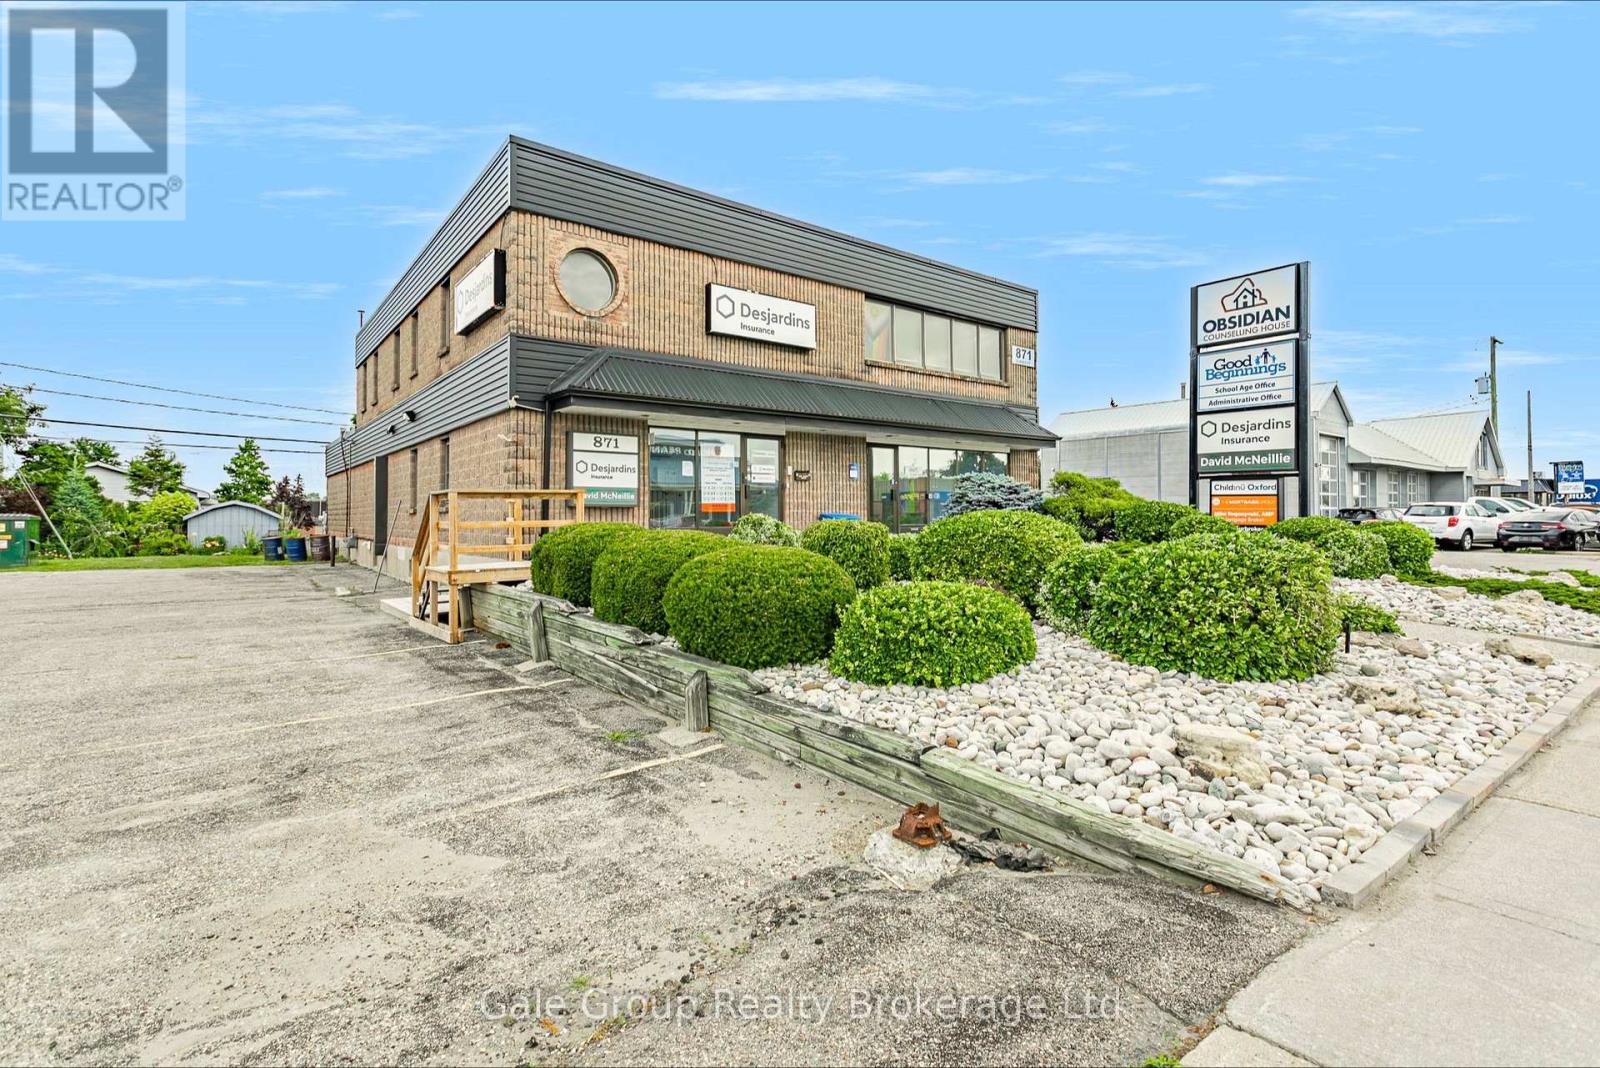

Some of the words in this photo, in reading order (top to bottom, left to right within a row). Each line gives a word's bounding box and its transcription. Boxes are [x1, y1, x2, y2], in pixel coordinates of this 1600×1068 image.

[465, 272, 493, 305] Desjardins
[740, 302, 811, 330] Desjardins
[1203, 305, 1291, 334] OBSIDIAN
[740, 322, 775, 335] Insurance
[1203, 326, 1259, 342] COUNSELLING
[1261, 321, 1291, 332] HOUSE
[1015, 347, 1032, 361] 871
[1213, 354, 1253, 371] Good
[1205, 362, 1287, 381] Beginnings
[1215, 384, 1238, 394] School
[1239, 383, 1254, 392] Age
[1254, 381, 1276, 390] Office
[1208, 395, 1260, 407] Administrative
[1260, 393, 1282, 402] Office
[1221, 418, 1292, 434] Desjardins
[593, 436, 619, 449] 871
[1220, 435, 1271, 445] Insurance
[1200, 455, 1232, 467] David
[1234, 453, 1291, 466] McNeillie
[590, 463, 636, 475] Desjardins
[1247, 483, 1278, 491] Oxford
[600, 491, 635, 500] McNeillie
